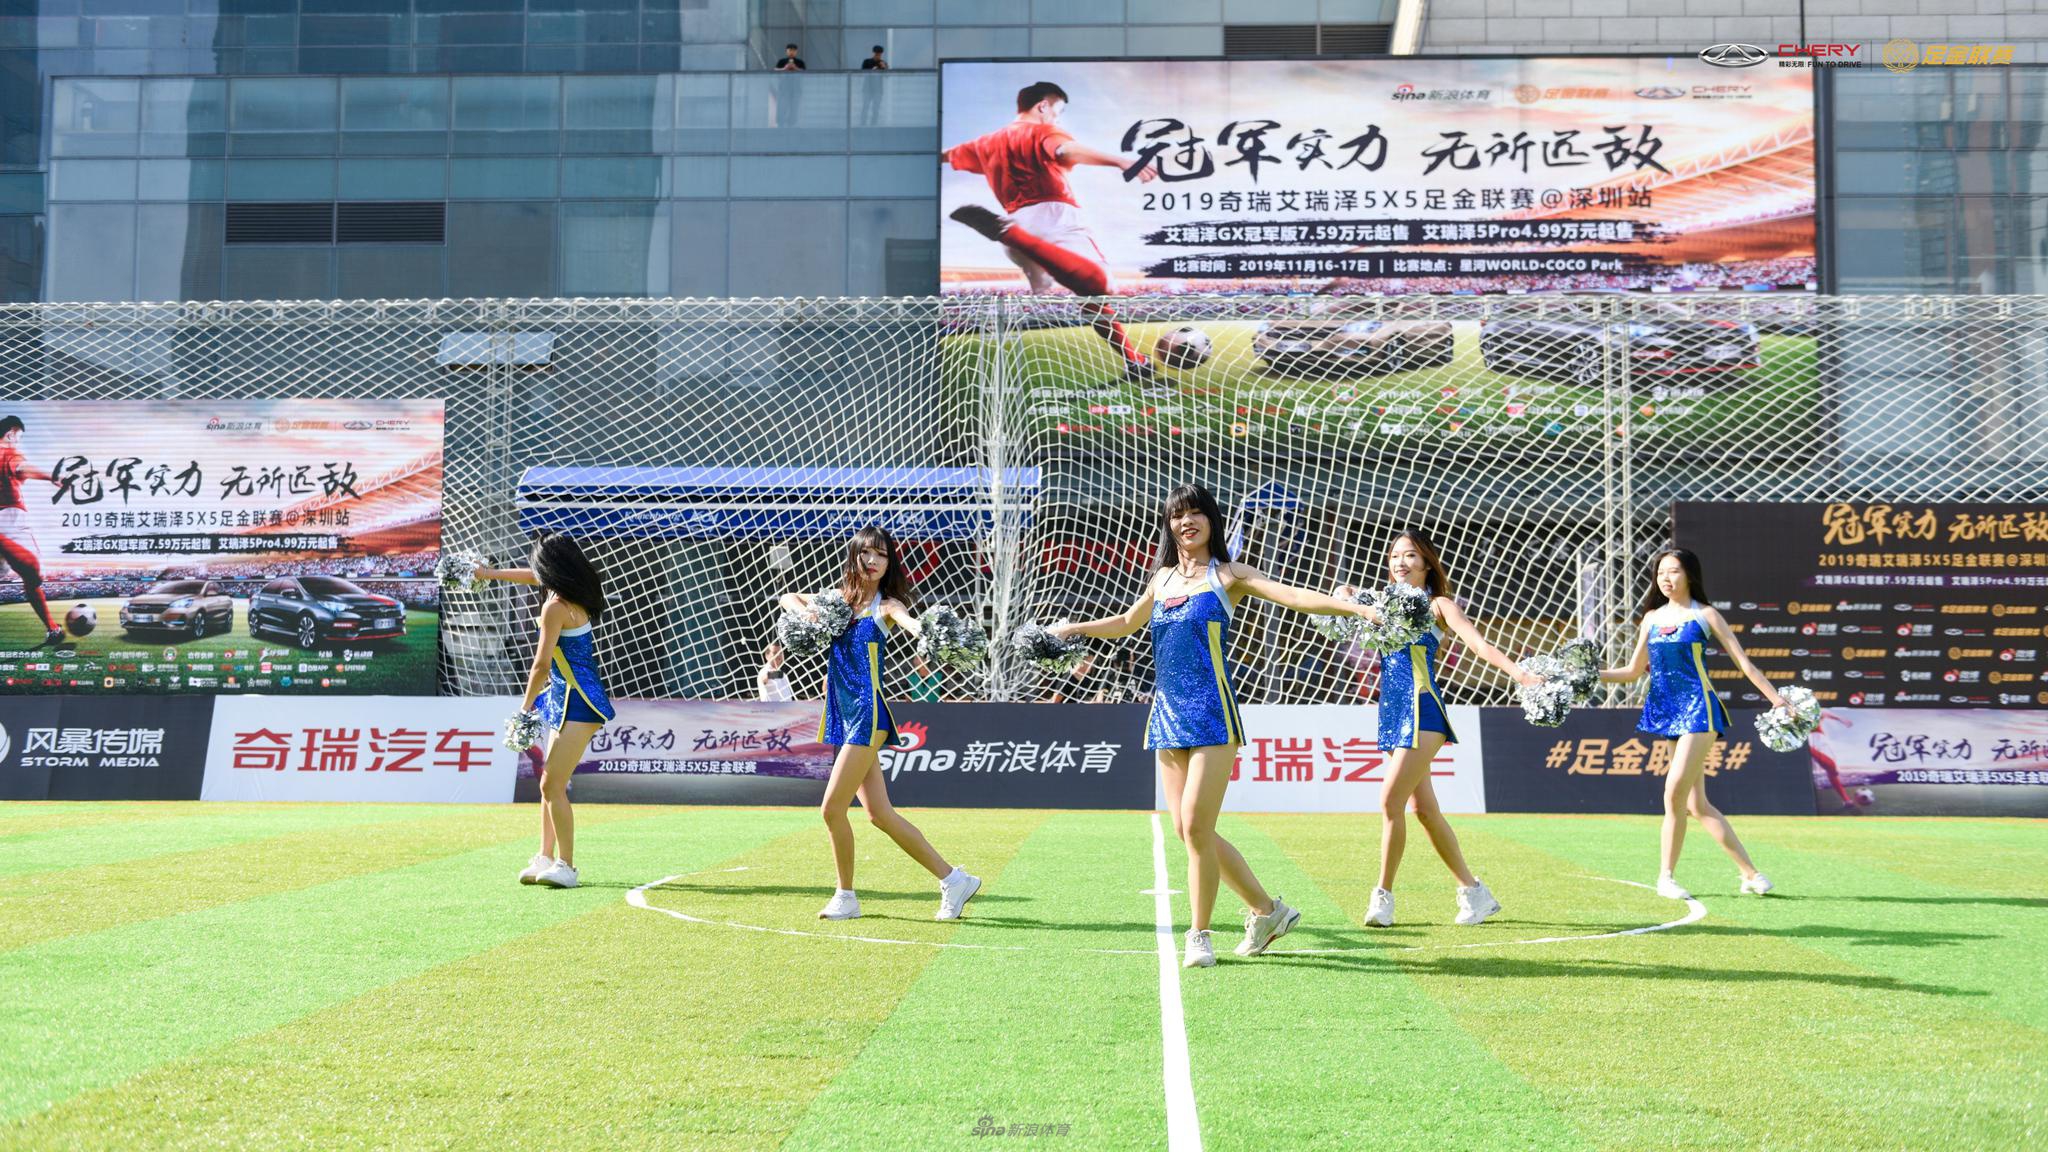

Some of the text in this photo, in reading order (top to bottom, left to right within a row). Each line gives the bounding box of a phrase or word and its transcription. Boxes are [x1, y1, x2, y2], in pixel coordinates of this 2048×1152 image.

[1391, 88, 1492, 102] sina 新浪体育
[1120, 118, 1673, 184] 冠军实力 无所匹敌
[1143, 187, 1653, 212] 2019奇瑞艾瑞泽5X5足金联赛@深圳站
[1164, 223, 1634, 243] 艾瑞泽GX冠军版7.59万元起售 艾瑞泽5Pro4.99万元起售
[1591, 259, 1623, 272] Park
[51, 455, 363, 506] 冠军实力 无所匹敌
[62, 510, 350, 528] 2019奇瑞艾瑞泽5X5足金联赛@深圳站
[1822, 503, 1938, 546] 冠军实力
[73, 536, 338, 552] 艾瑞泽GX冠军版7.59万元起售 艾瑞泽5Pro4.99万元起售
[1818, 553, 2048, 567] 2019奇瑞艾瑞泽5X5足金联赛@深圳
[1951, 576, 2048, 587] 艾瑞泽5Pro4.99万元
[22, 728, 166, 754] 风暴传媒
[232, 727, 496, 773] 奇瑞汽车
[693, 728, 794, 753] 无所匹敌
[1869, 733, 2048, 764] 冠军实力 无所
[20, 757, 161, 768] STORM MEDIA
[598, 760, 758, 774] 2019奇瑞艾瑞泽5X5足金联赛
[878, 740, 1122, 782] sina 新浪体育
[1229, 737, 1456, 783] 瑞汽
